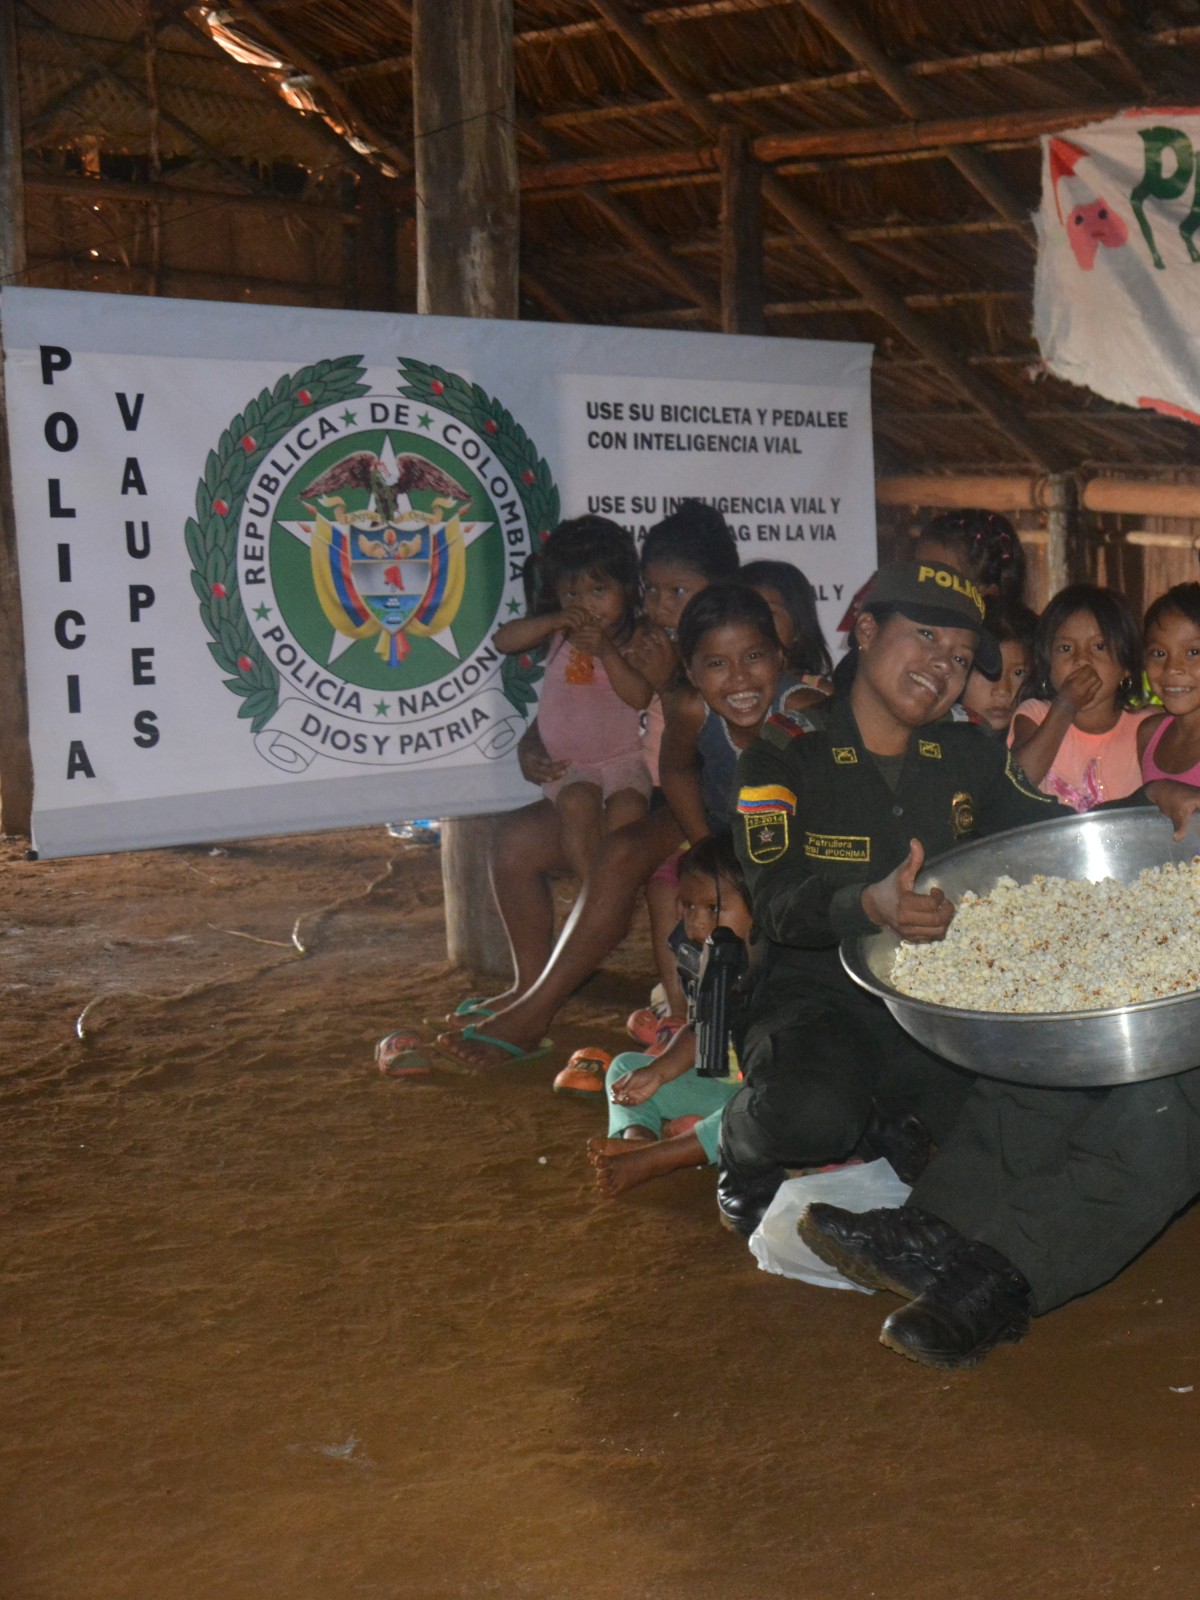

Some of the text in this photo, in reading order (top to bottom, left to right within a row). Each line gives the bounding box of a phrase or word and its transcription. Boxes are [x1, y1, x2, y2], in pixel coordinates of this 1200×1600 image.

[586, 401, 848, 428] USE SU BICICLETA Y PEDALEE
[588, 431, 802, 454] CON INTELIGENCIA VIAL
[370, 402, 410, 426] DE
[442, 424, 526, 582] COLOMBIA
[588, 496, 840, 514] USE SU INIGENCIA VIAL Y
[757, 525, 780, 541] EN
[786, 525, 804, 541] LA
[810, 525, 837, 541] VIA
[39, 345, 95, 780] POLICIA
[115, 392, 160, 749] VAUPES
[833, 584, 844, 601] Y
[398, 623, 506, 717] NACION
[400, 708, 490, 755] PATRIA
